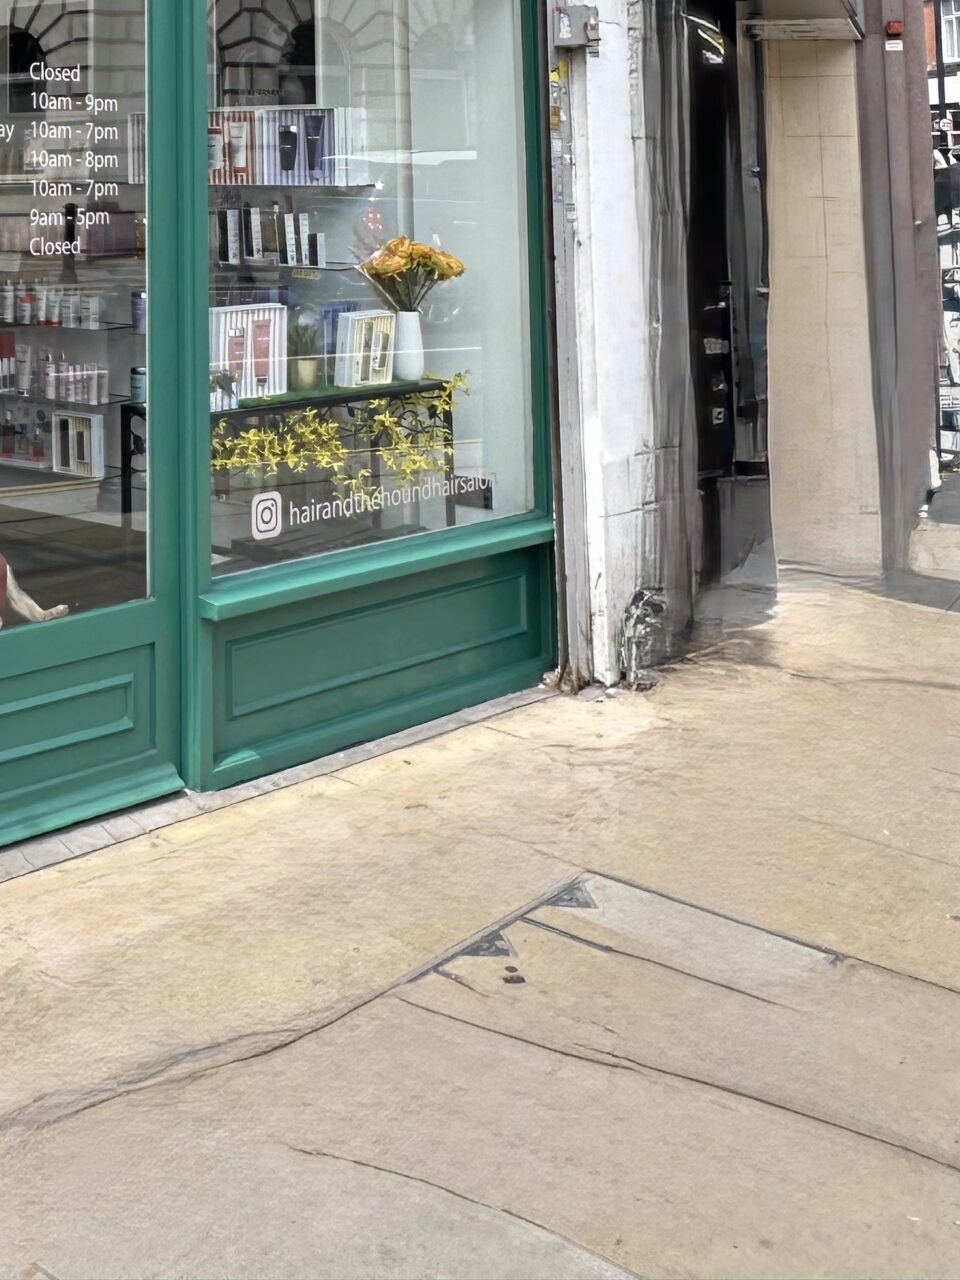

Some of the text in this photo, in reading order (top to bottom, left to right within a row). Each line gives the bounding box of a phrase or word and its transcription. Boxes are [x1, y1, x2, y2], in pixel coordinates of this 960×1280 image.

[29, 61, 80, 82] Closed
[31, 92, 72, 110] 10am
[85, 94, 118, 115] 9pm
[31, 121, 72, 139] 10am
[85, 123, 118, 143] 7pm
[31, 151, 72, 168] 10am
[85, 151, 118, 169] 8pm
[31, 180, 72, 197] 10am
[85, 180, 118, 199] 7pm
[30, 209, 63, 226] 9am
[76, 209, 110, 227] 5pm
[29, 237, 81, 256] Closed
